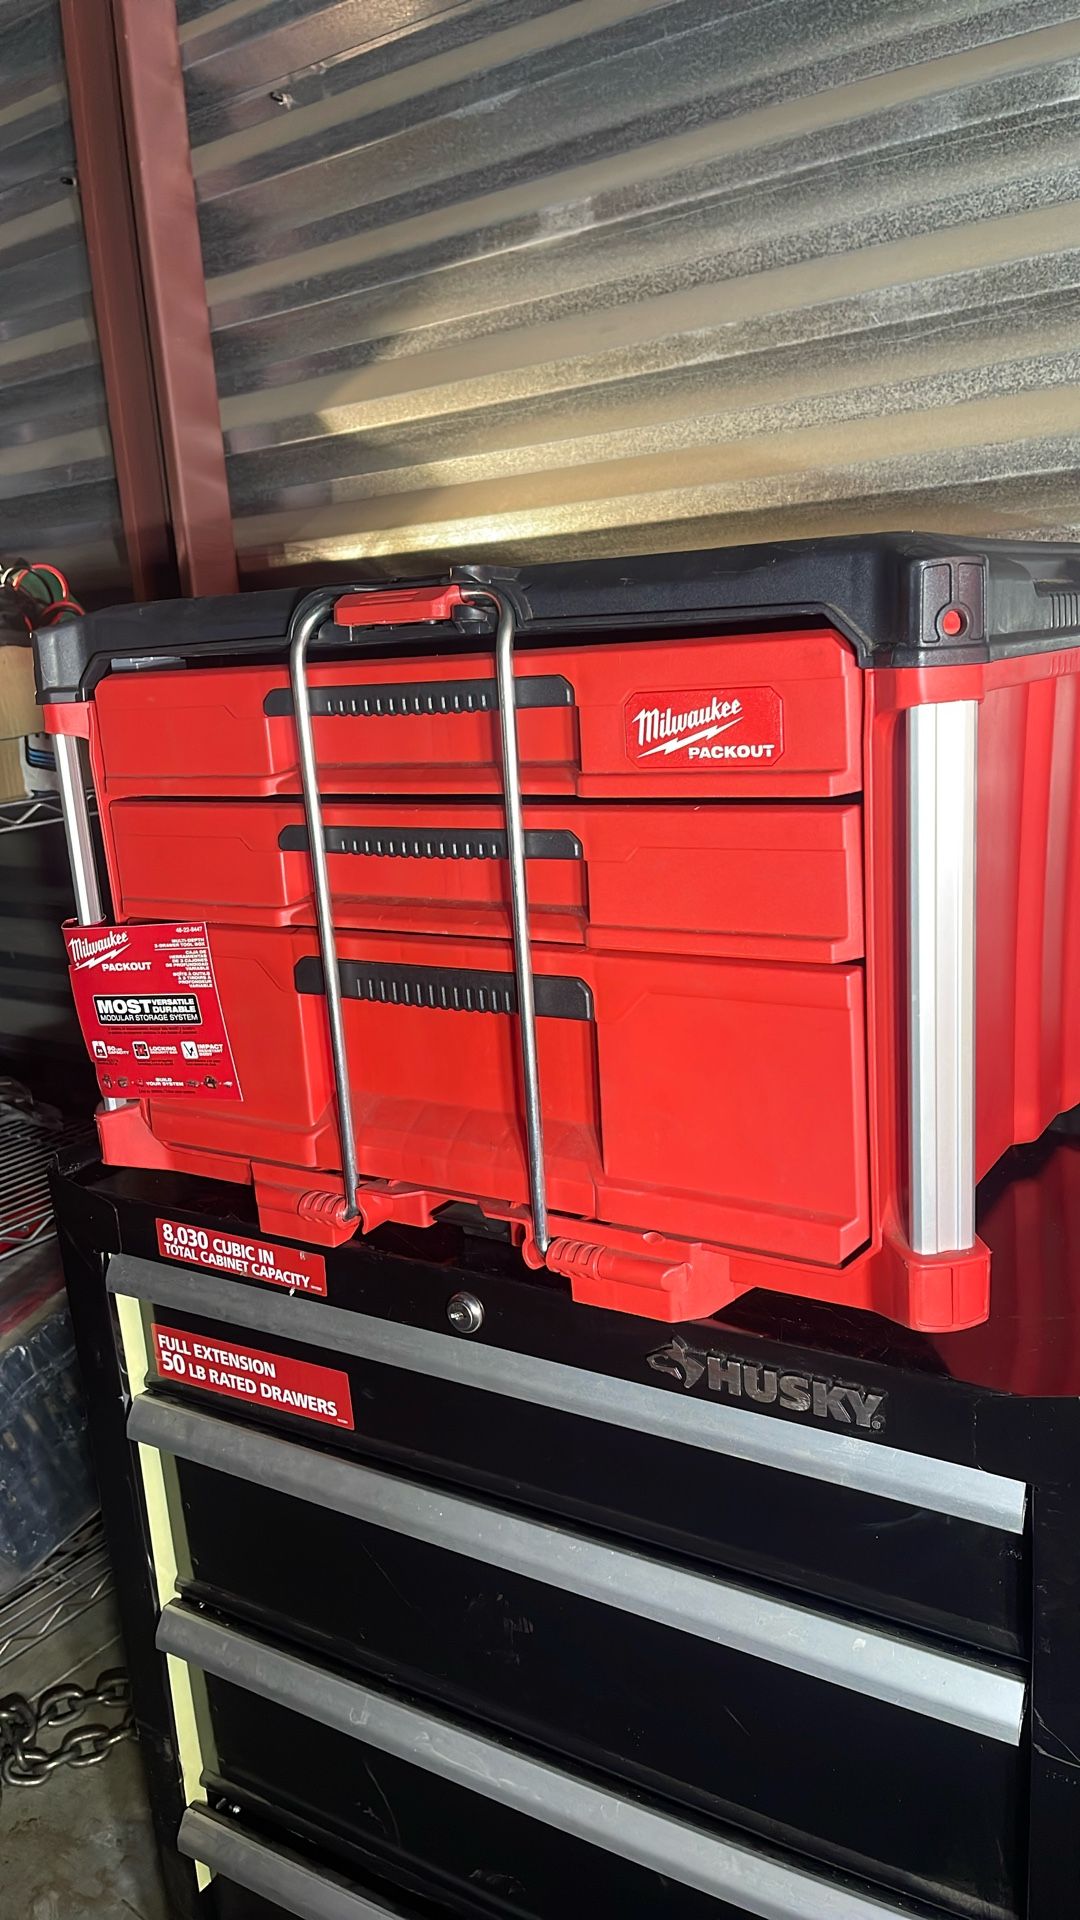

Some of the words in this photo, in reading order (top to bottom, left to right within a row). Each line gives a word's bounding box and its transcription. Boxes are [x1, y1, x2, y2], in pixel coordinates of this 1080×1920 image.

[632, 697, 743, 746] Milwaukee
[688, 744, 775, 760] PACKOUT
[68, 931, 129, 962] Milwaukee
[102, 961, 152, 972] PACKOUT
[96, 1000, 151, 1014] MOST
[100, 1014, 135, 1022] MODULAR
[169, 1013, 198, 1021] SYSTEM
[151, 998, 194, 1006] VERSATILE
[152, 1005, 196, 1014] DURABLE
[162, 1223, 208, 1248] 8,030
[212, 1239, 254, 1261] CUBIC
[258, 1248, 275, 1266] IN
[163, 1242, 198, 1261] TOTAL
[200, 1250, 248, 1273] CABINET
[251, 1262, 310, 1289] CAPACITY
[157, 1334, 191, 1356] FULL
[193, 1344, 276, 1378] EXTENSION
[161, 1351, 186, 1375] 50
[188, 1362, 207, 1381] LB
[209, 1369, 257, 1394] RATED
[260, 1382, 338, 1417] DRAWERS
[706, 1354, 884, 1429] HUSKY
